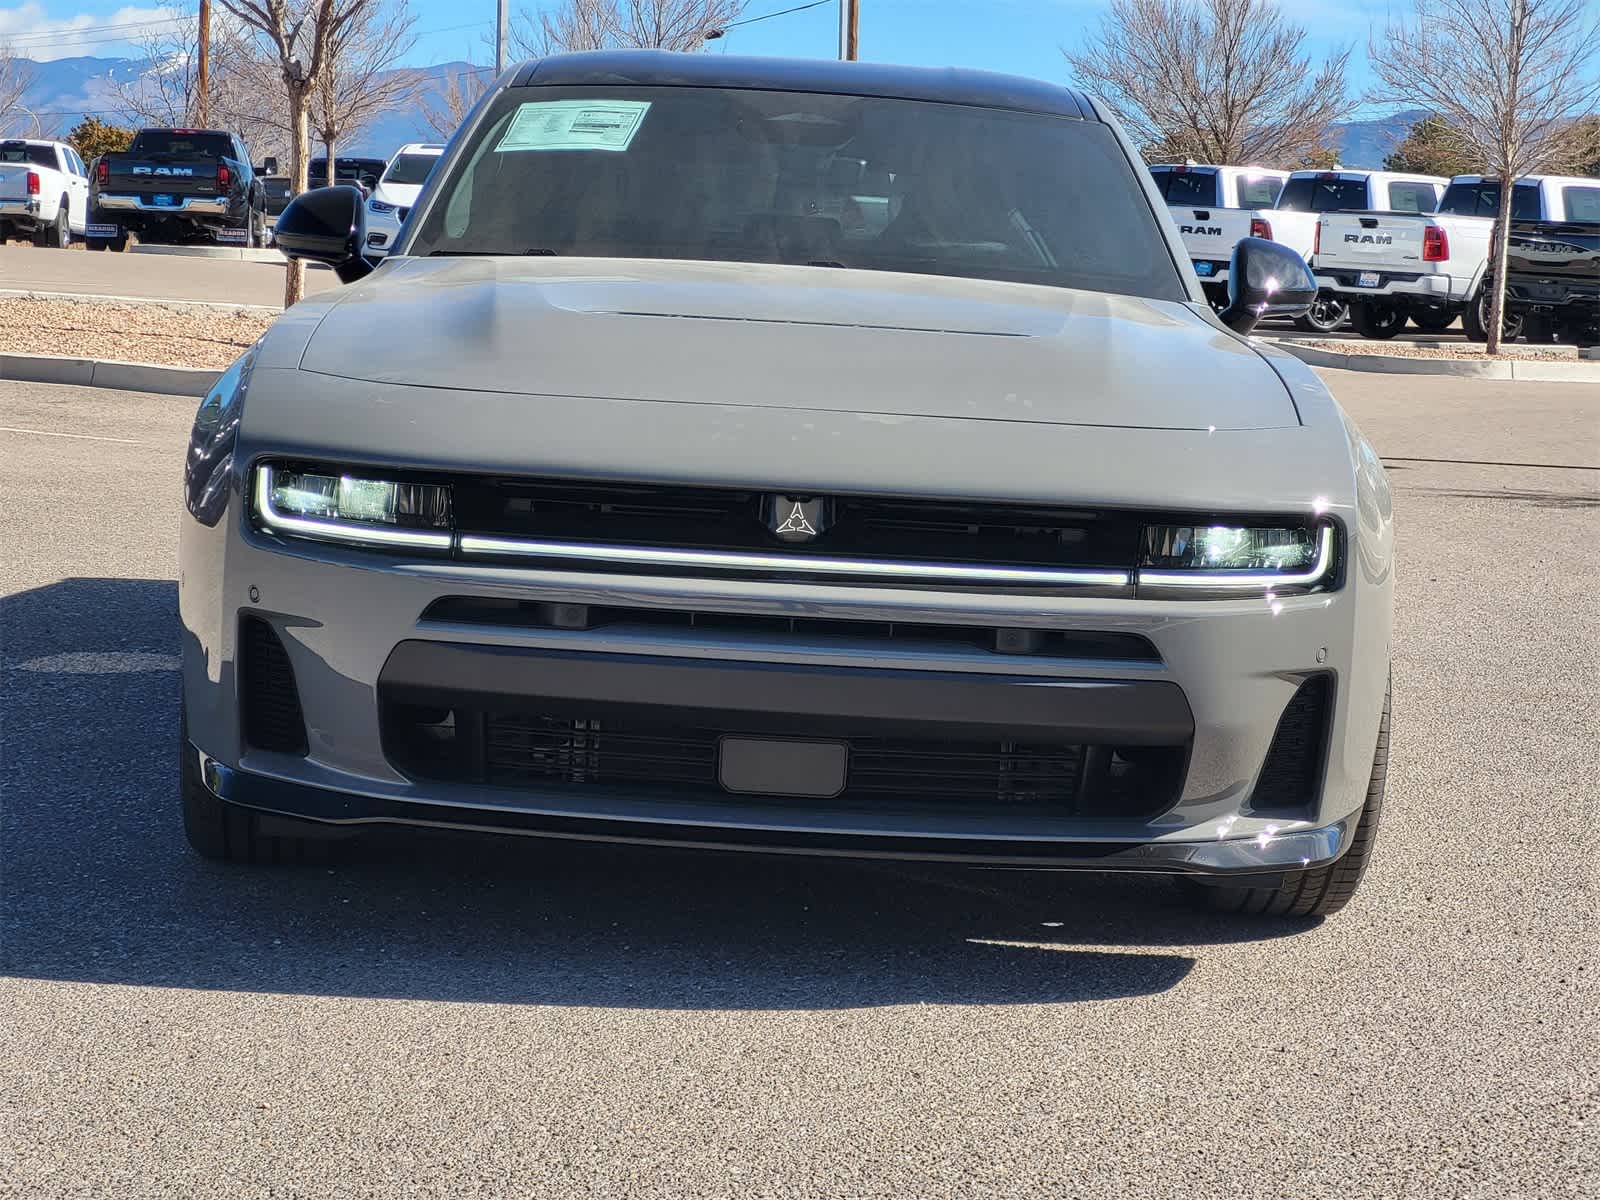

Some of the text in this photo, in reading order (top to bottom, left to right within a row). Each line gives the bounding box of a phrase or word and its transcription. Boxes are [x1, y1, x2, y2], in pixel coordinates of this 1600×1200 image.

[132, 166, 193, 176] RAM
[1180, 225, 1222, 236] RAM
[1344, 233, 1392, 245] RAM
[1520, 242, 1573, 254] RAM
